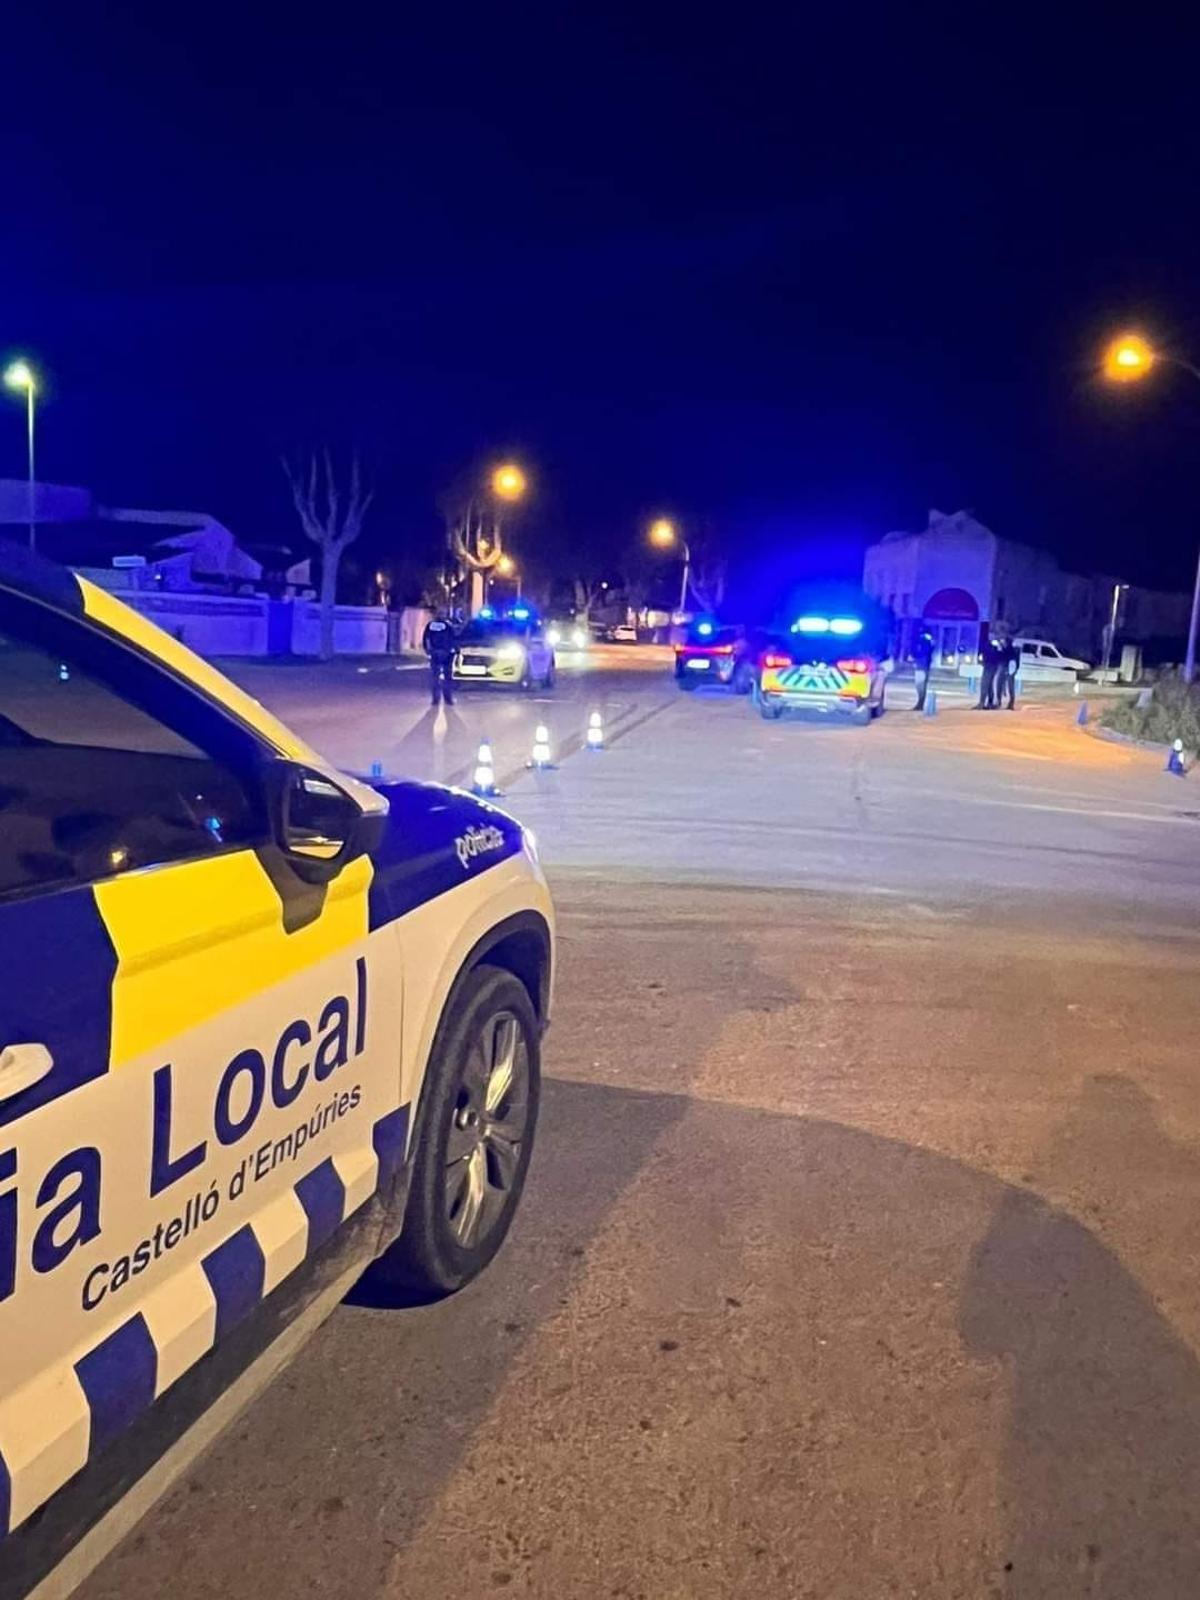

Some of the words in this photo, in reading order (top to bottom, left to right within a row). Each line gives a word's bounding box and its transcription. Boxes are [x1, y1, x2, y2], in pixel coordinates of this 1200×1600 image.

[150, 956, 367, 1198] Local
[82, 1179, 219, 1311] Castelló
[229, 1084, 361, 1200] d'Empúries
